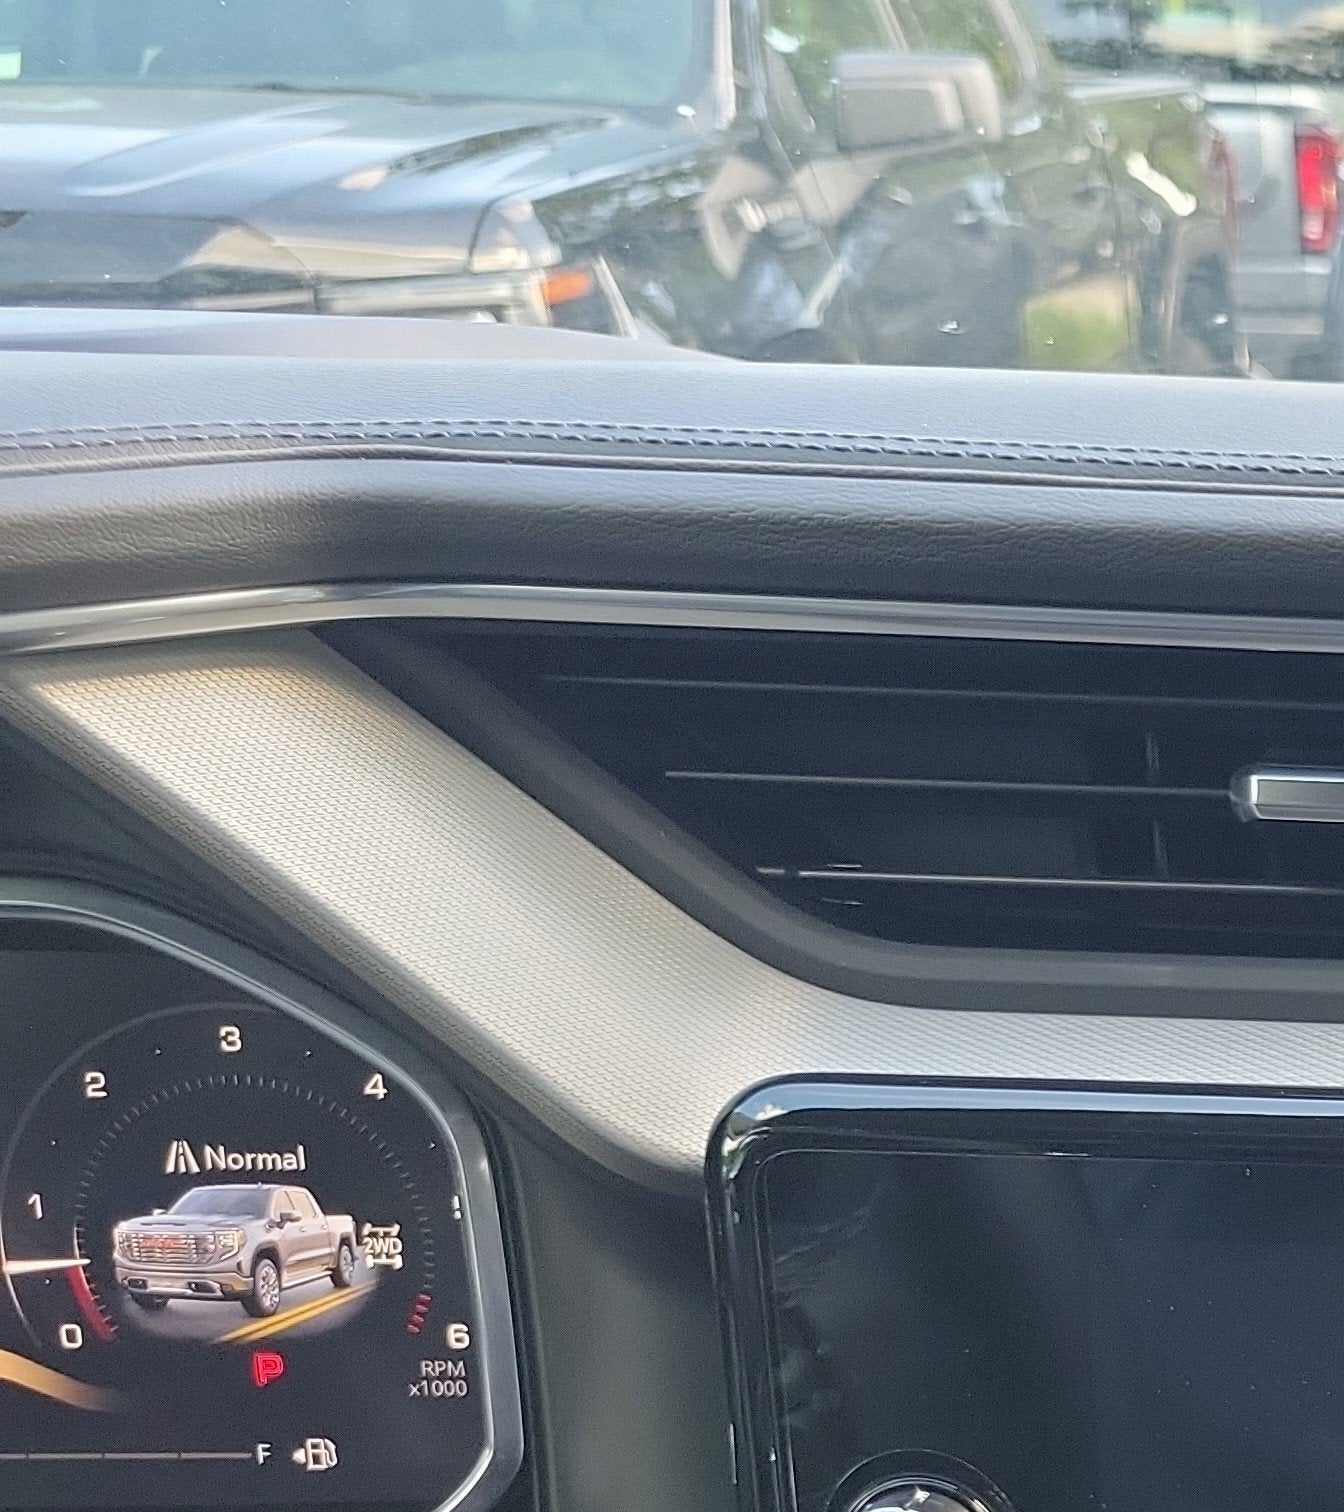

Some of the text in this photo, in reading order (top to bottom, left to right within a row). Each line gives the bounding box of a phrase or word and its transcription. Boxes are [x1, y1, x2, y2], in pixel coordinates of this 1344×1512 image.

[219, 1026, 242, 1051] 3
[84, 1072, 108, 1098] 2
[364, 1074, 387, 1099] 4
[204, 1145, 306, 1172] Normal
[27, 1193, 43, 1219] 1
[362, 1236, 403, 1256] 2WD
[59, 1324, 82, 1349] 0
[446, 1324, 470, 1350] 6
[252, 1351, 283, 1386] P
[421, 1361, 466, 1377] RPM
[409, 1380, 468, 1398] x1000
[256, 1443, 272, 1464] F
